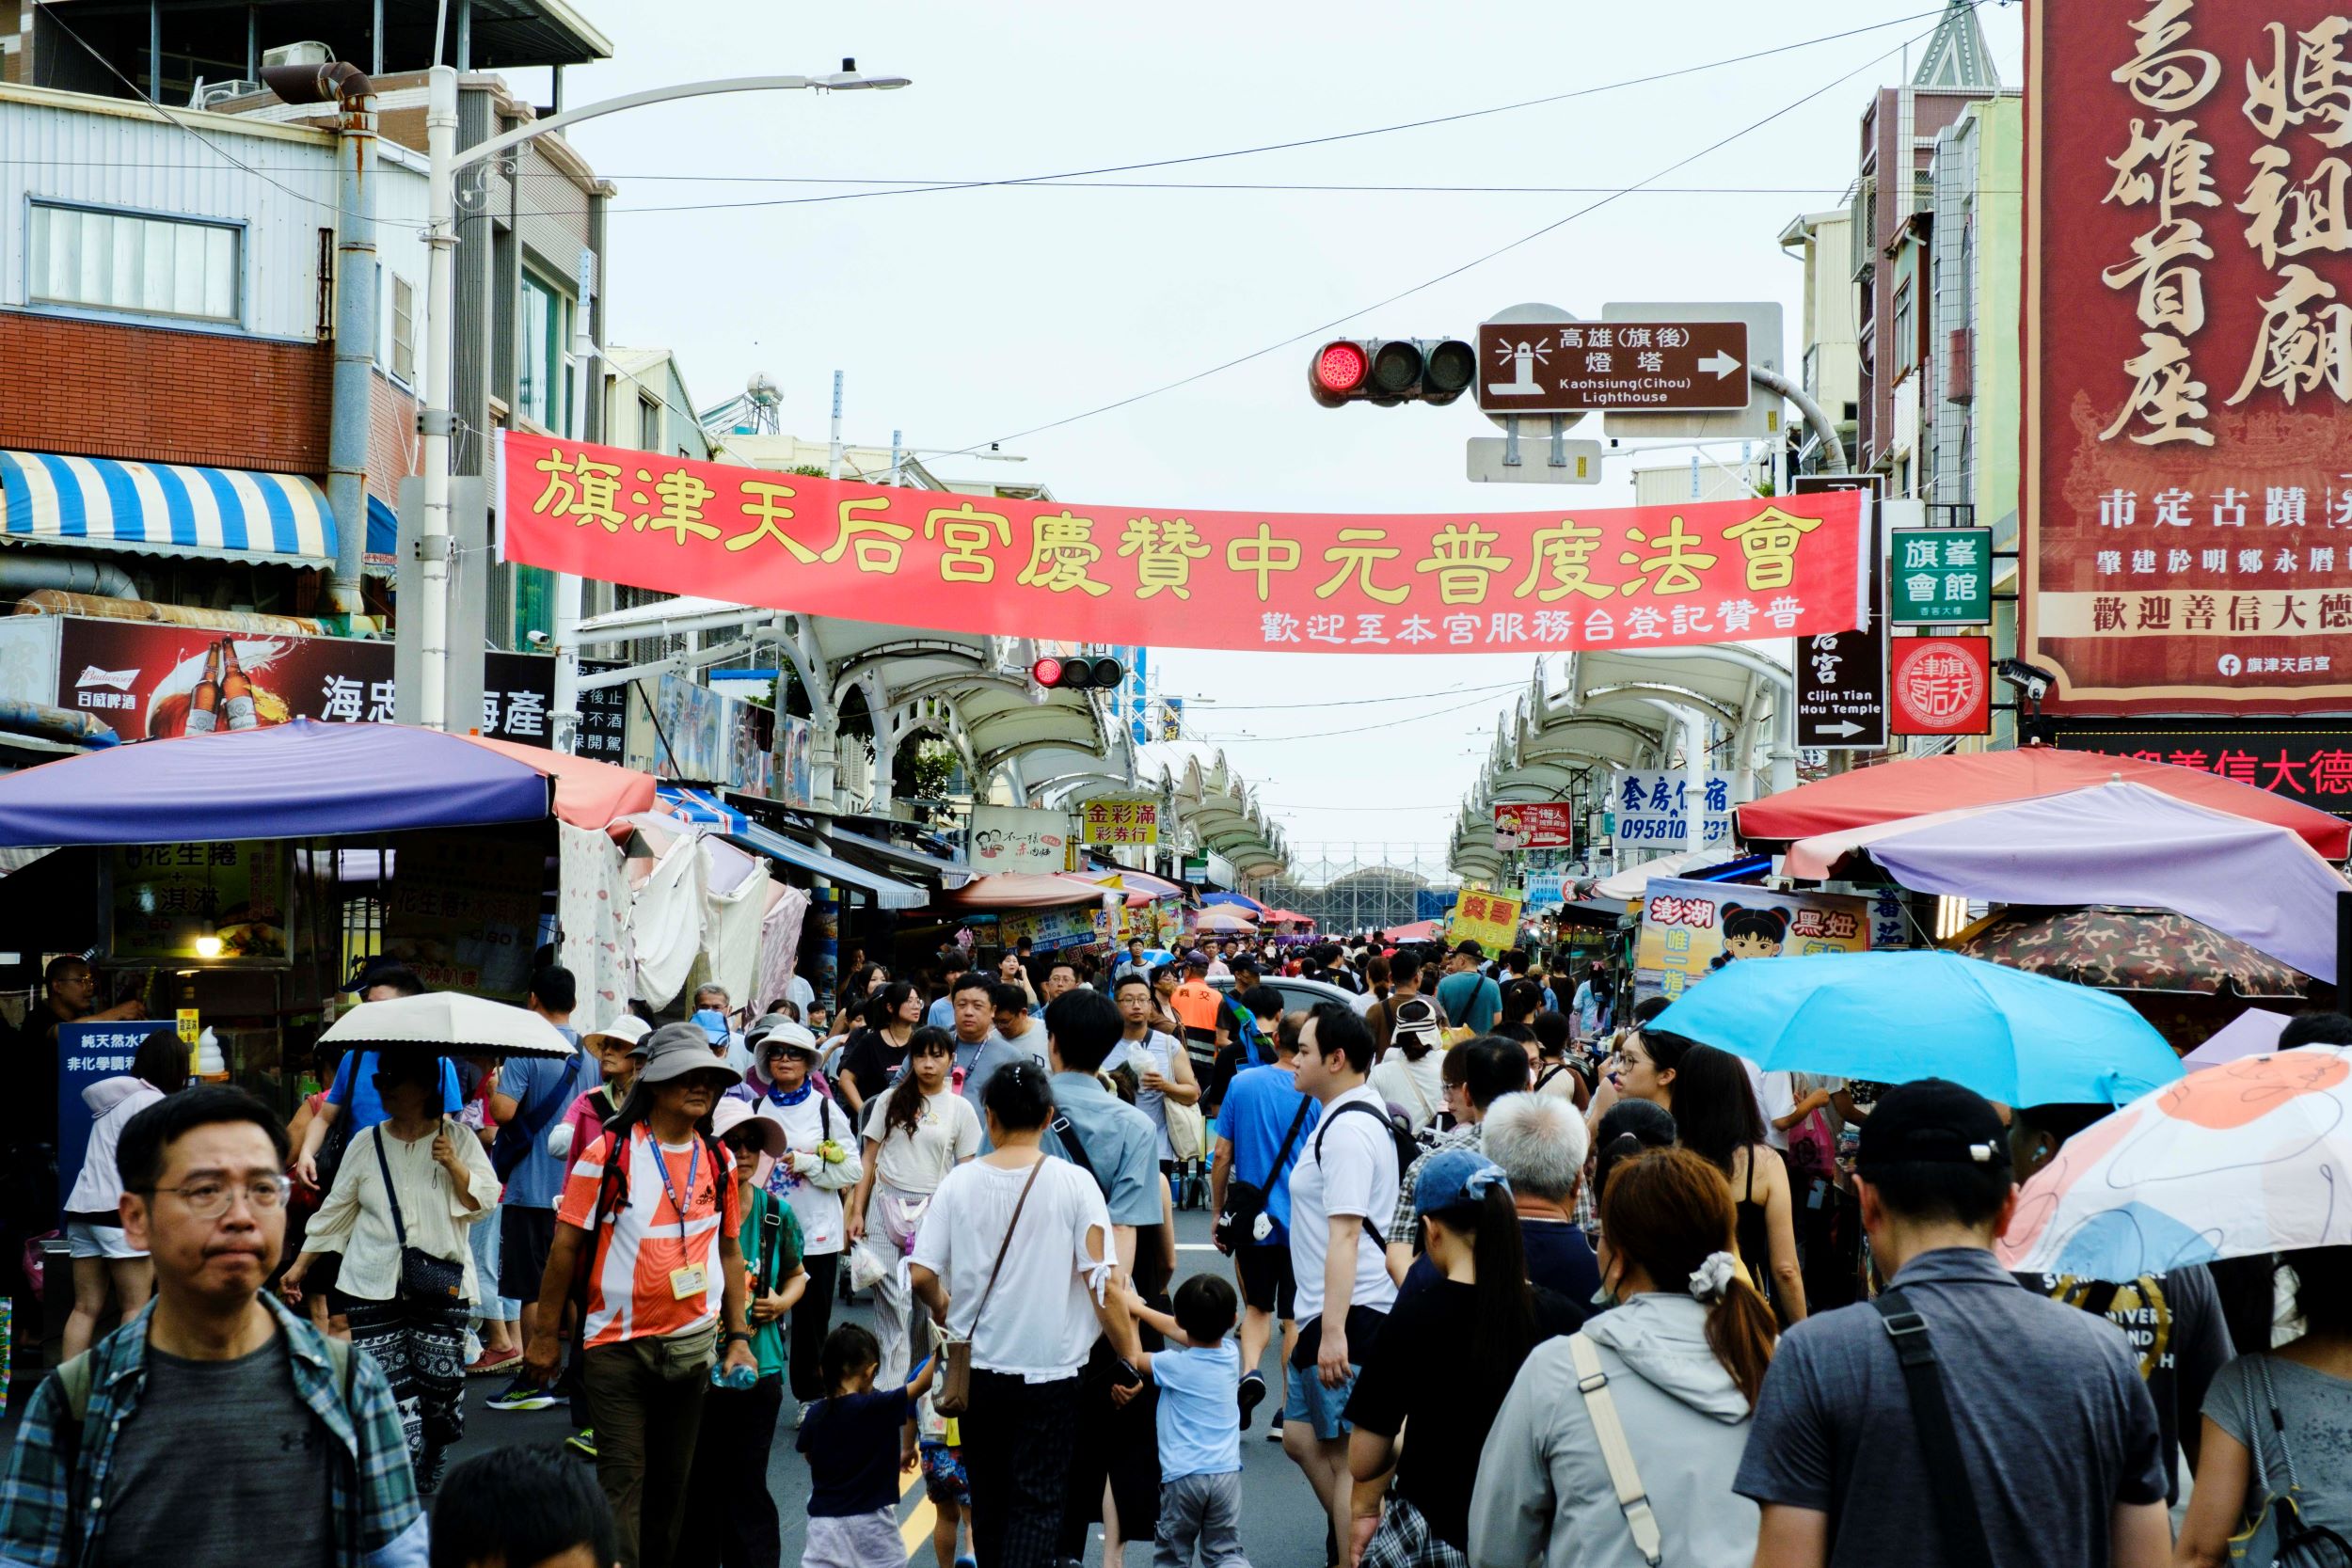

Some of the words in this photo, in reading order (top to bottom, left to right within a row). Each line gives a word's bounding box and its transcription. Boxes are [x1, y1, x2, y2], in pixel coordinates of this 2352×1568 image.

[2099, 0, 2223, 446] 高雄首座
[1560, 378, 1691, 390] Kaohsiung(Cihou)
[1582, 391, 1667, 405] Lighthouse
[2097, 486, 2307, 529] 市定古蹟
[2096, 546, 2352, 575] 肇建於明鄭永曆
[1905, 573, 1978, 602] 會館
[2092, 594, 2352, 632] 歡迎善信大德
[2247, 656, 2330, 673] 旗津天后宮
[1807, 690, 1838, 702] Cijin
[1843, 690, 1872, 701] Tian
[1800, 705, 1828, 715] Hou
[1833, 704, 1881, 717] Temple
[1089, 803, 1156, 825] 金彩滿
[1095, 827, 1148, 843] 彩券行
[1650, 895, 1715, 929] 澎湖
[1791, 909, 1859, 940] 黑妞
